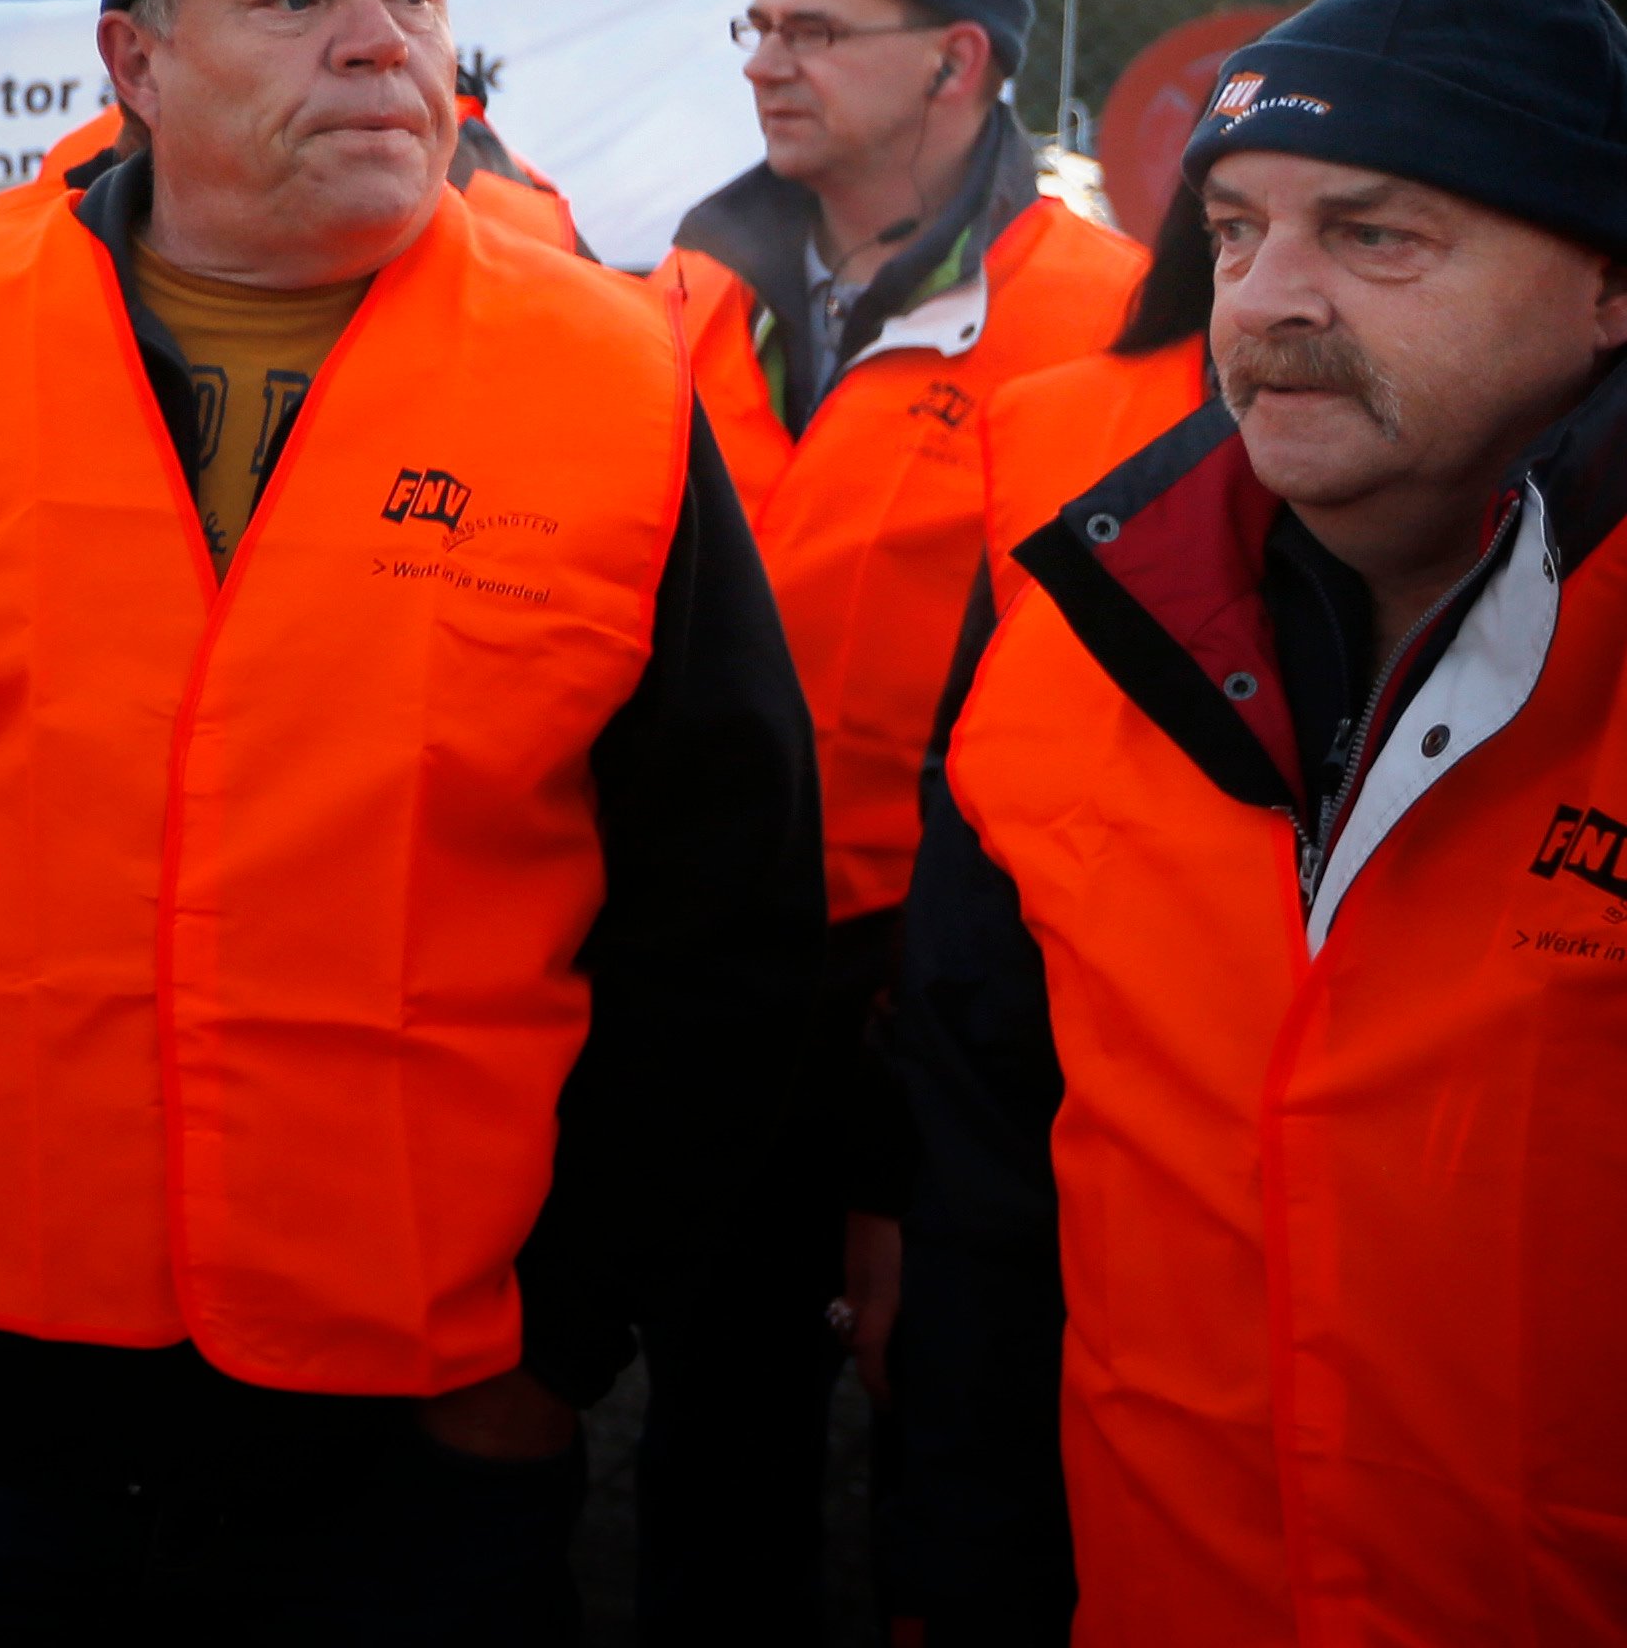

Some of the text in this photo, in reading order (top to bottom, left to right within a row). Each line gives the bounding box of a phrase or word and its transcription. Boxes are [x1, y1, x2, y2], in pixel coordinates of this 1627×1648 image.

[1213, 75, 1264, 113] FNV
[384, 473, 470, 524] FNV
[1535, 930, 1626, 962] Werkt in
